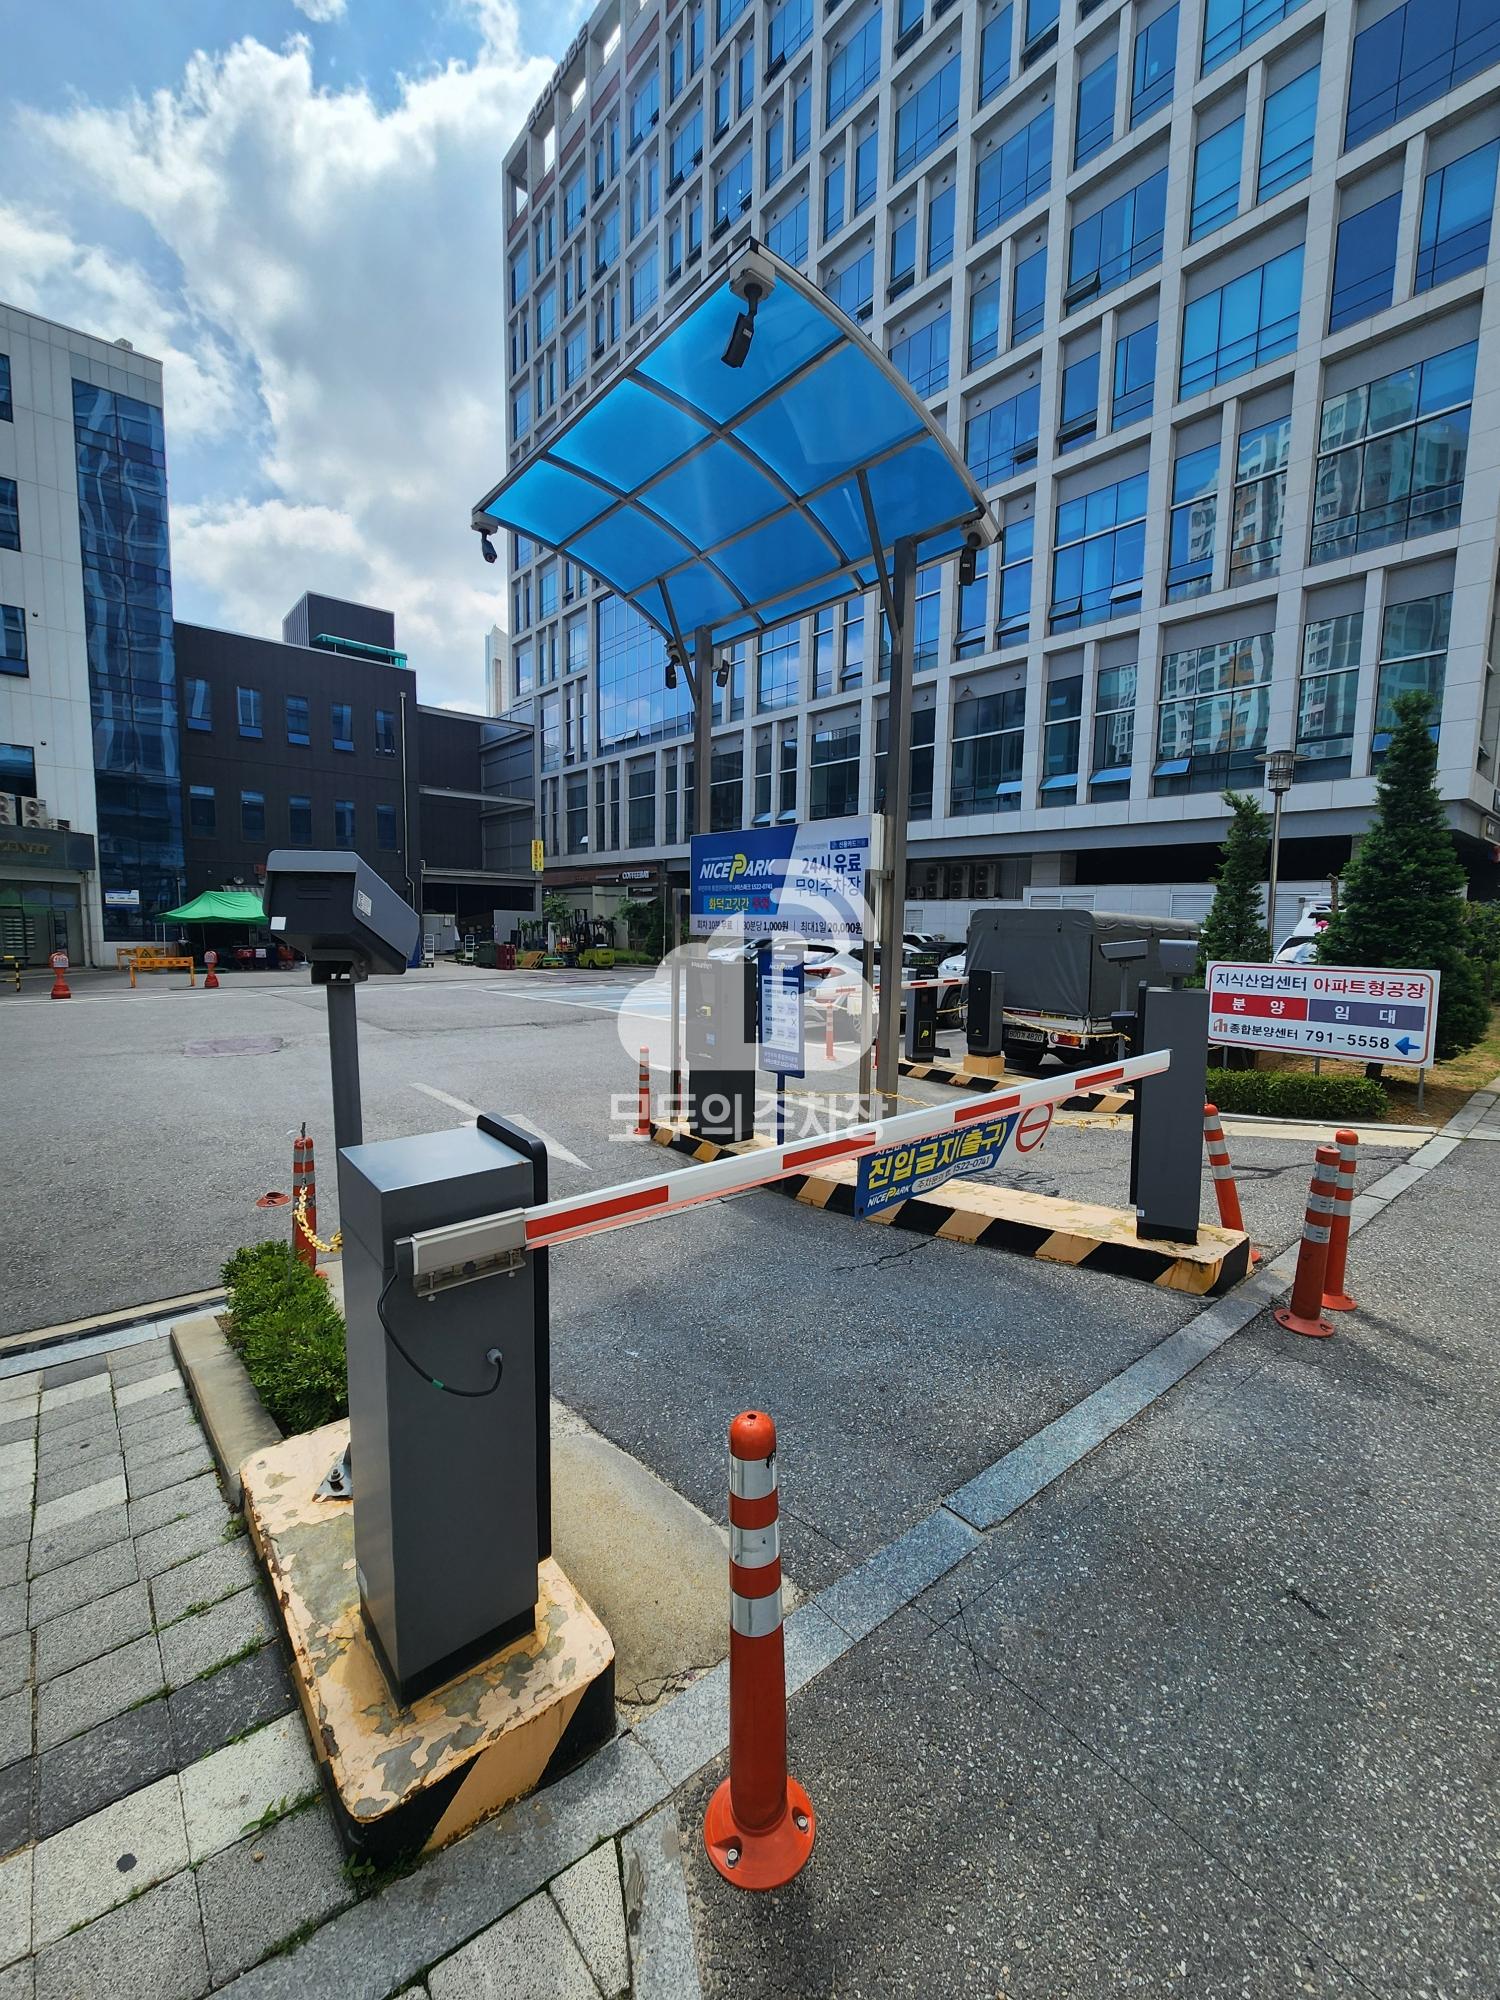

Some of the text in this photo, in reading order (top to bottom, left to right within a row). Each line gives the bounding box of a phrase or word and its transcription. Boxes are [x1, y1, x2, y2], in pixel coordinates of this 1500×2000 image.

[834, 853, 861, 875] 유료
[794, 876, 862, 898] 무인주차장
[763, 921, 789, 933] 1,000원
[1216, 973, 1426, 998] 지식산업센터 아파트형공장
[1229, 1023, 1390, 1049] 종합분양센터 791-5558
[868, 1122, 1008, 1190] 진입금지(출구)
[952, 1156, 990, 1173] 1522-0741
[867, 1183, 912, 1208] NICEPARK
